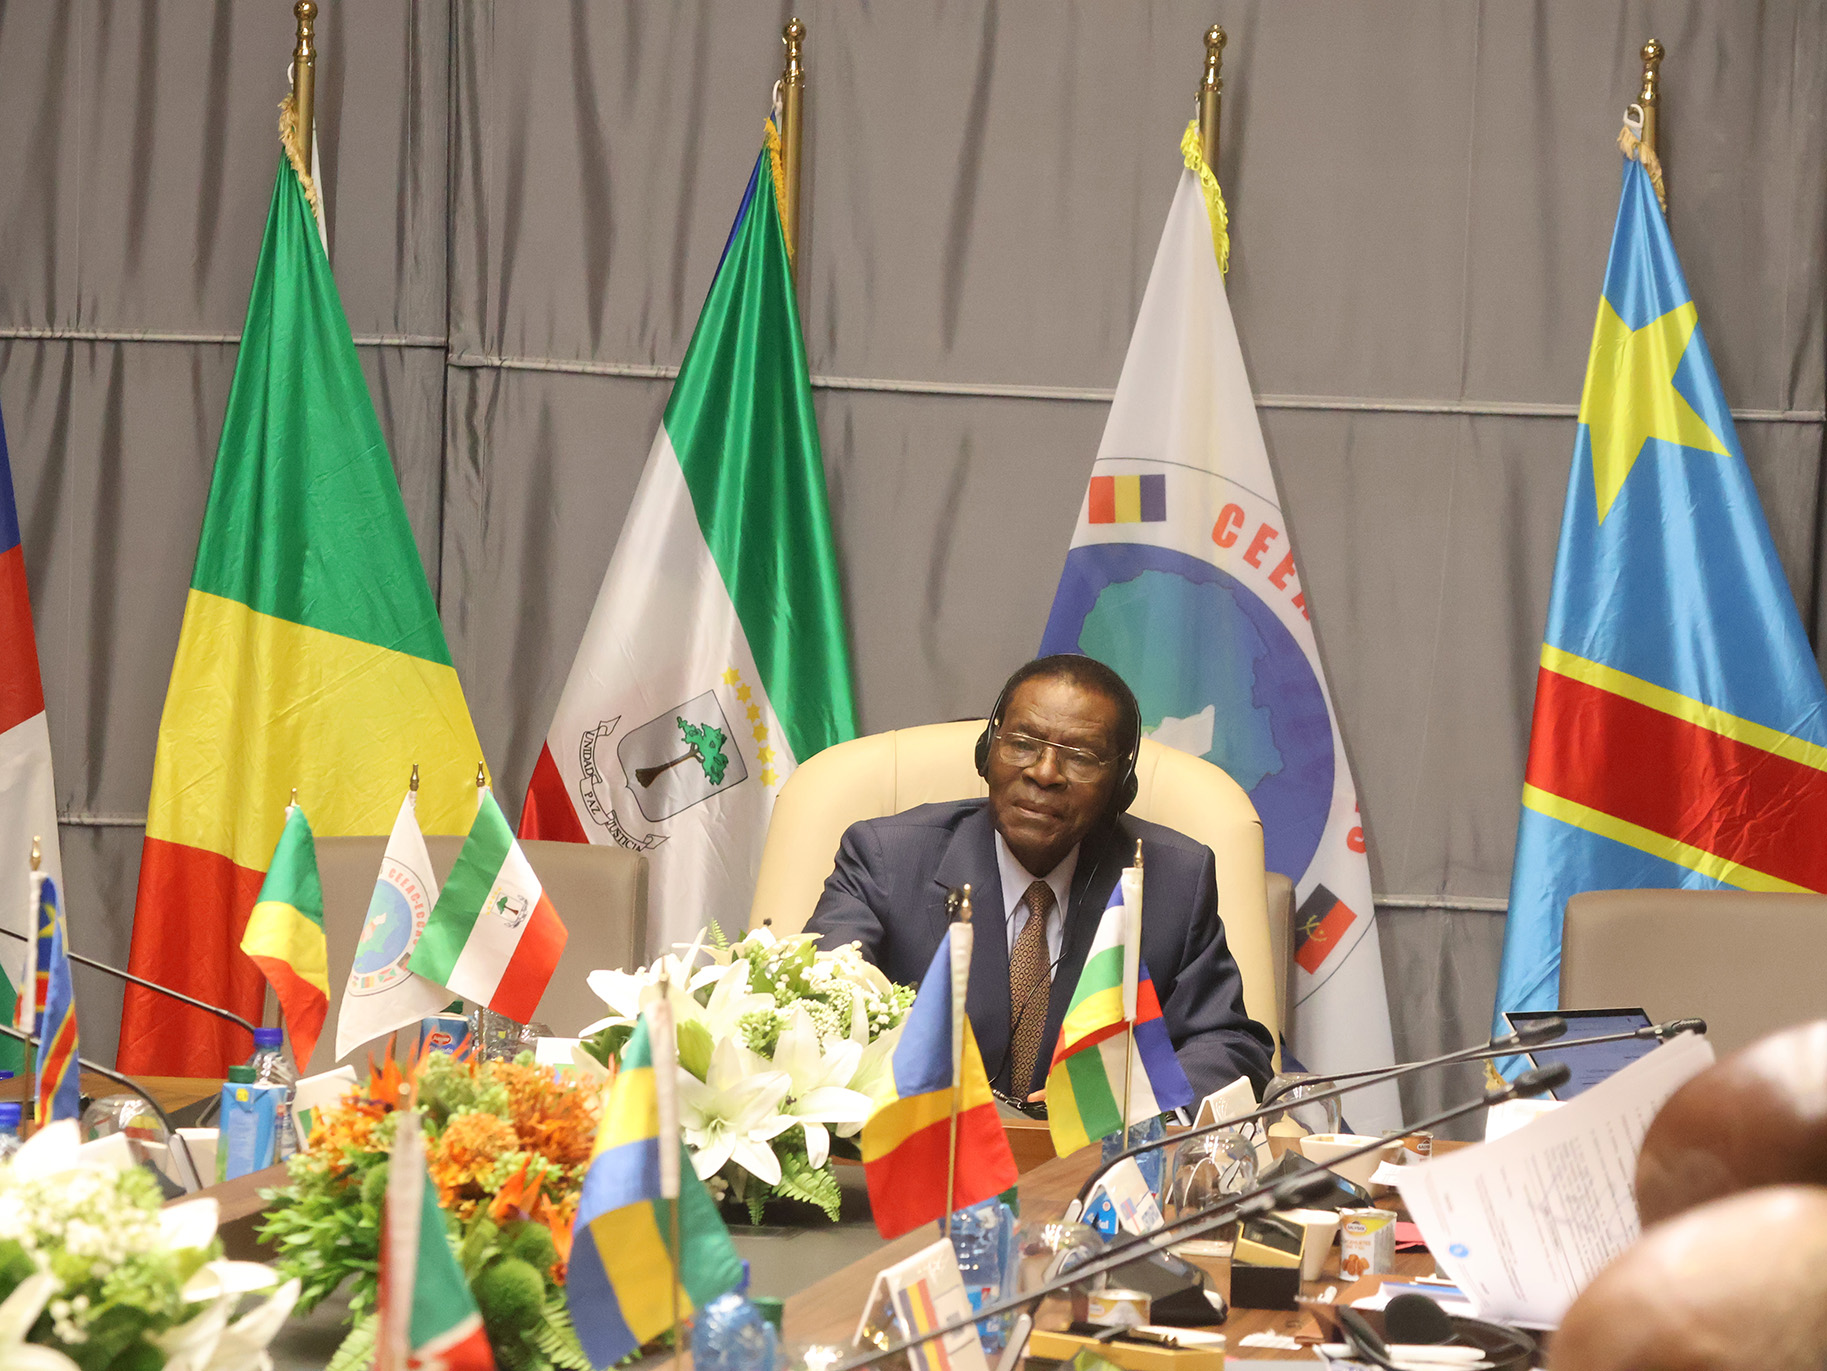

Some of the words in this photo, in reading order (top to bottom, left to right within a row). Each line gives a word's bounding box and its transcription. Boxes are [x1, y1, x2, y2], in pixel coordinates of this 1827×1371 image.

[583, 731, 595, 777] UNIDAD
[584, 791, 601, 815] PAZ
[606, 820, 642, 852] JUSTICIA
